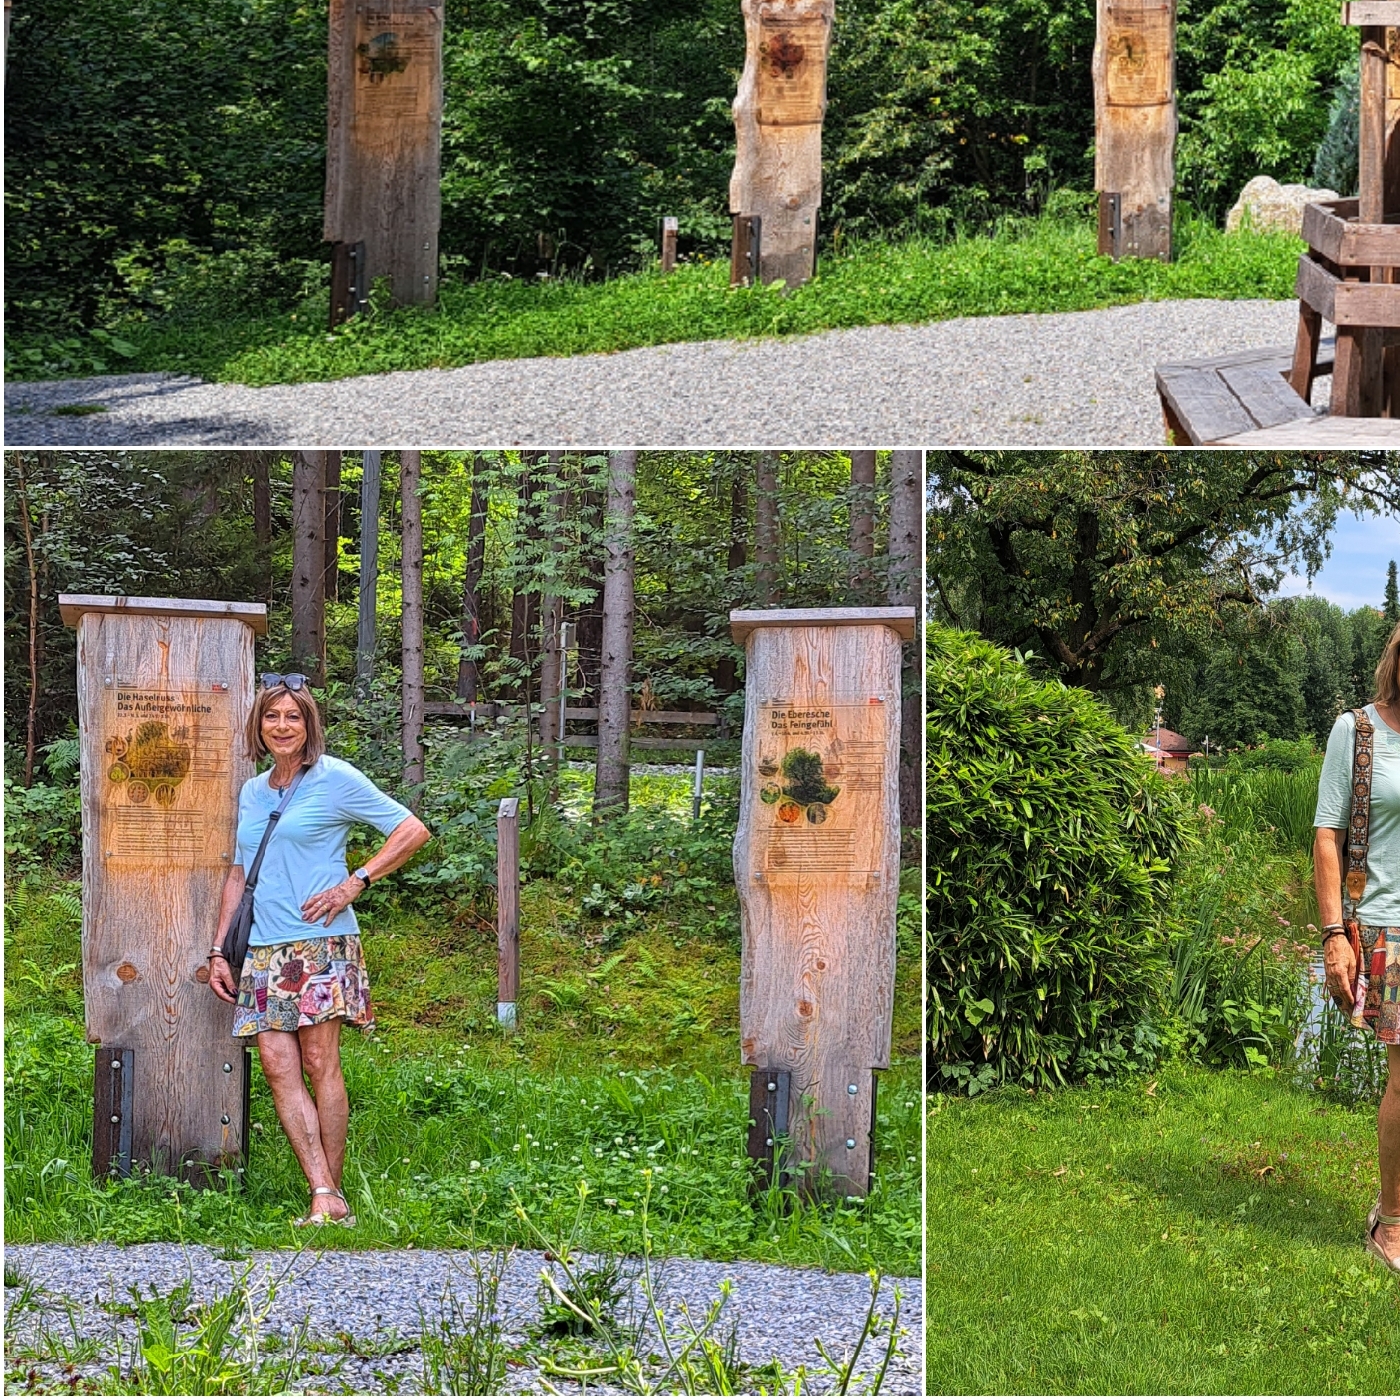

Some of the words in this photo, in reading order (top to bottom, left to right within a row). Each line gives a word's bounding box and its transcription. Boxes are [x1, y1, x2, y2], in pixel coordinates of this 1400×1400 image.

[117, 692, 131, 701] Die
[133, 693, 175, 702] Haselnuss
[117, 702, 133, 711] Das
[135, 702, 212, 714] Außergewöhnliche
[772, 710, 786, 719] Die
[788, 710, 830, 719] Eberesche
[771, 721, 787, 729] Das
[790, 719, 833, 730] Feingefühl
